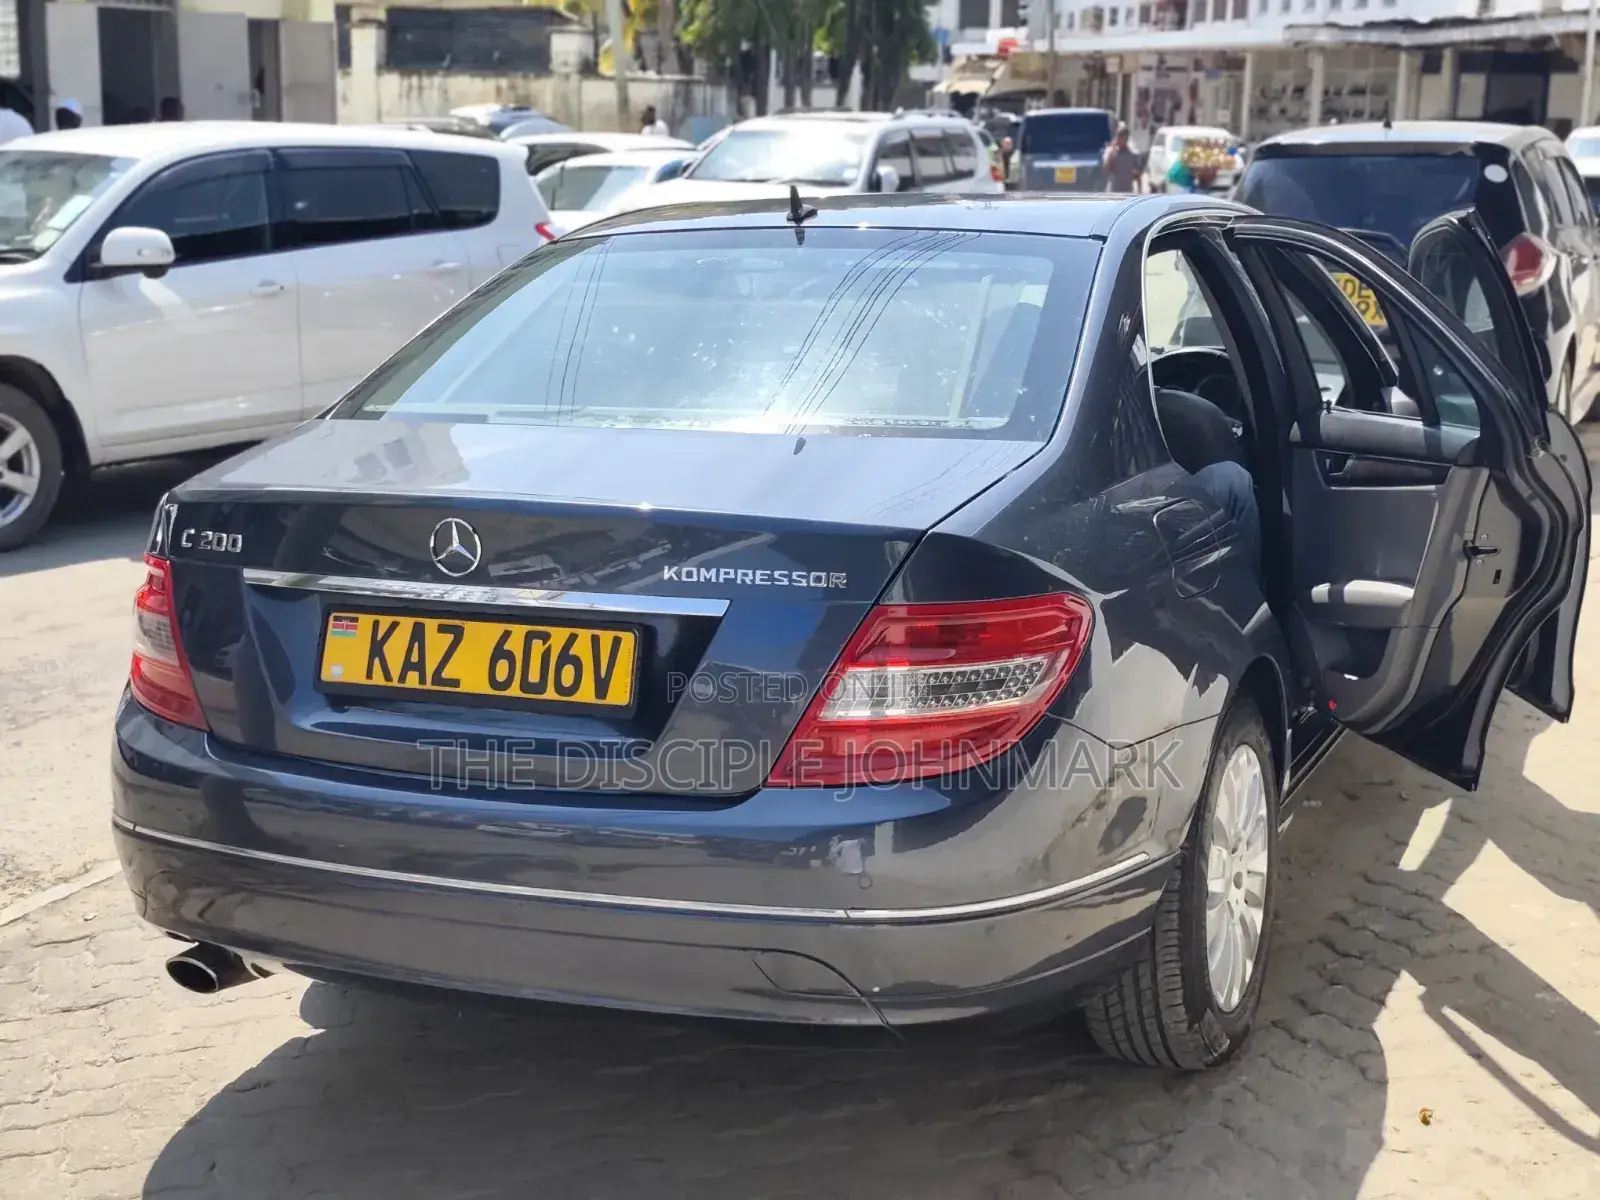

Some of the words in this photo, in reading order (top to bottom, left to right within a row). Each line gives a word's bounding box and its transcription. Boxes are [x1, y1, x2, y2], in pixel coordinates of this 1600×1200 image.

[181, 528, 195, 548] C
[199, 530, 242, 553] 200
[663, 565, 847, 589] KOMPRESSOR
[365, 619, 465, 689] KAZ
[488, 628, 622, 701] 606V
